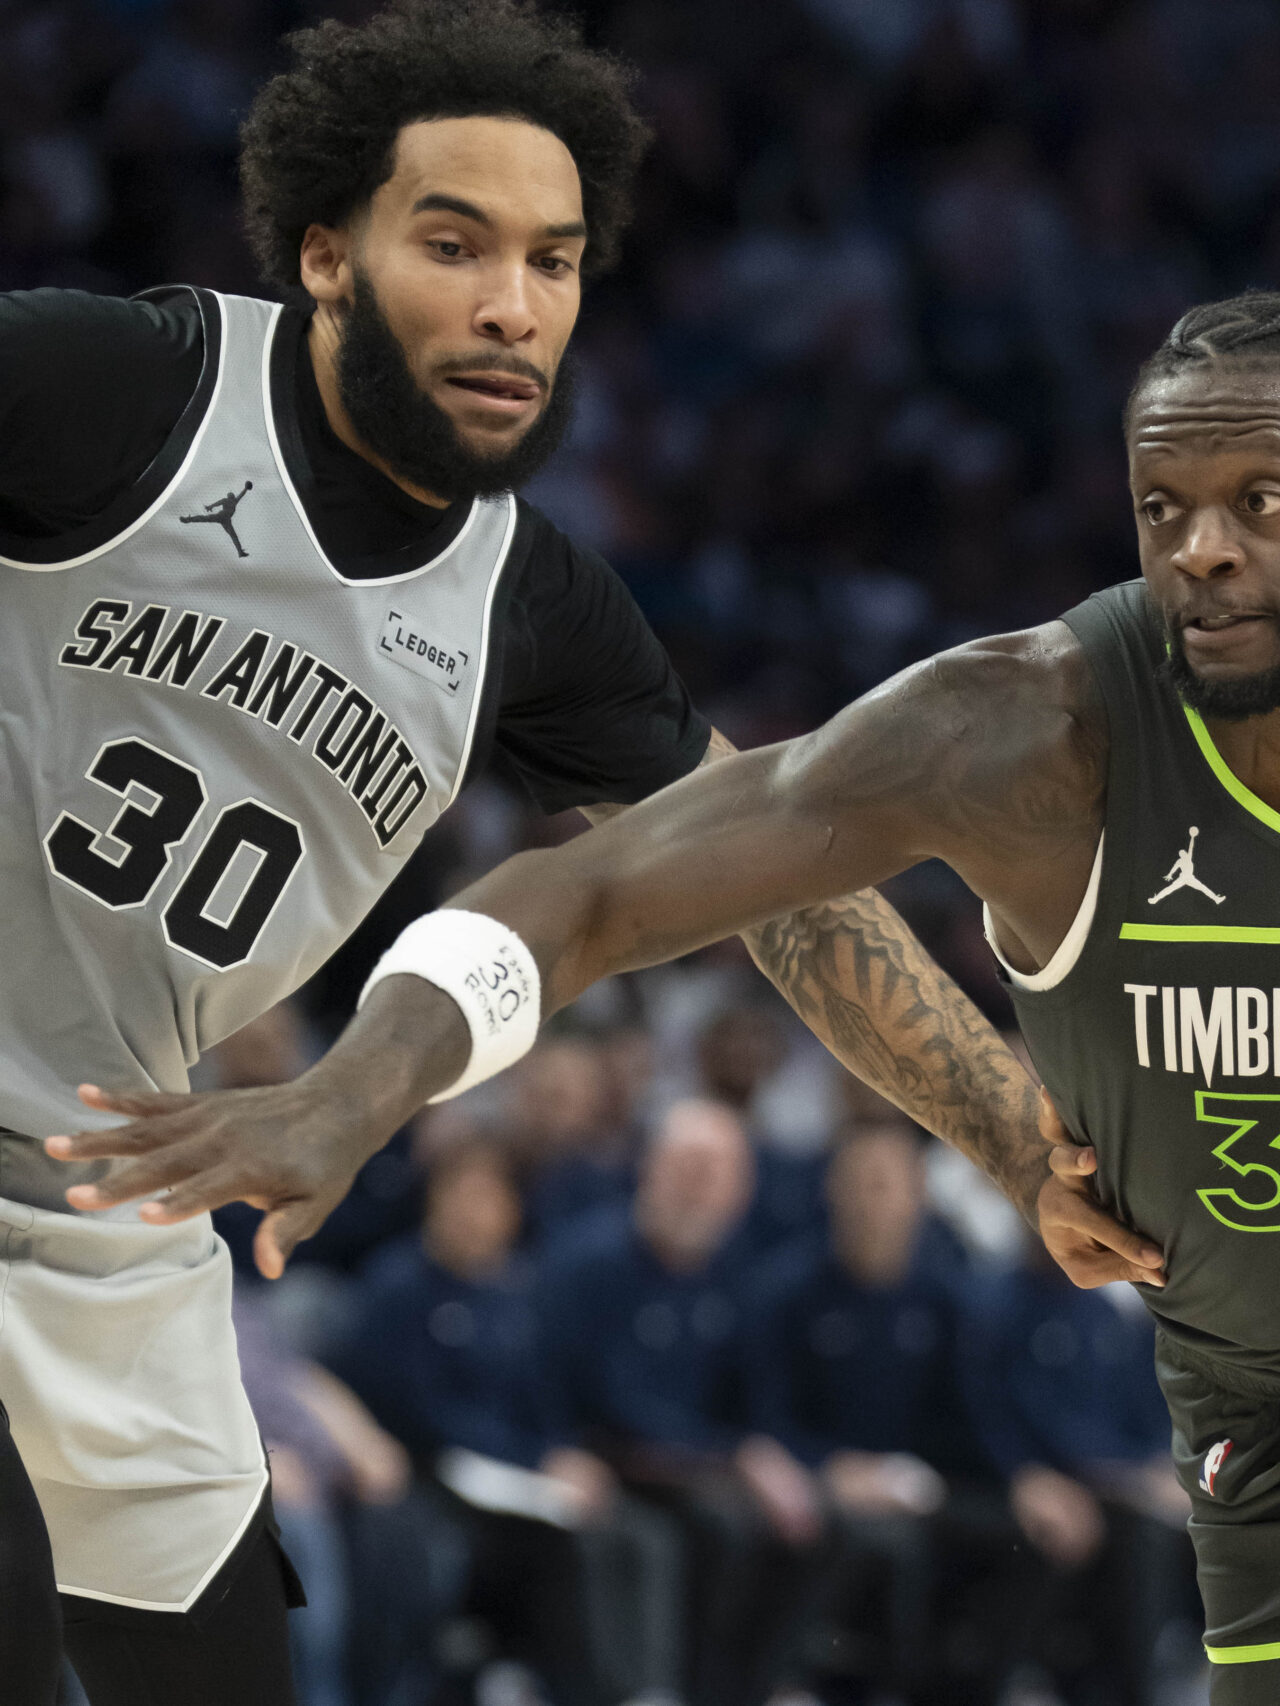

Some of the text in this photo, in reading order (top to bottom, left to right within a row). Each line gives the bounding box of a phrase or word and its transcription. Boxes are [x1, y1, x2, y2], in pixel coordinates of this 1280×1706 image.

[58, 598, 430, 851] SAN ANTONIO
[395, 627, 456, 675] LEDGER
[43, 736, 307, 974] 30
[479, 961, 521, 1022] 30
